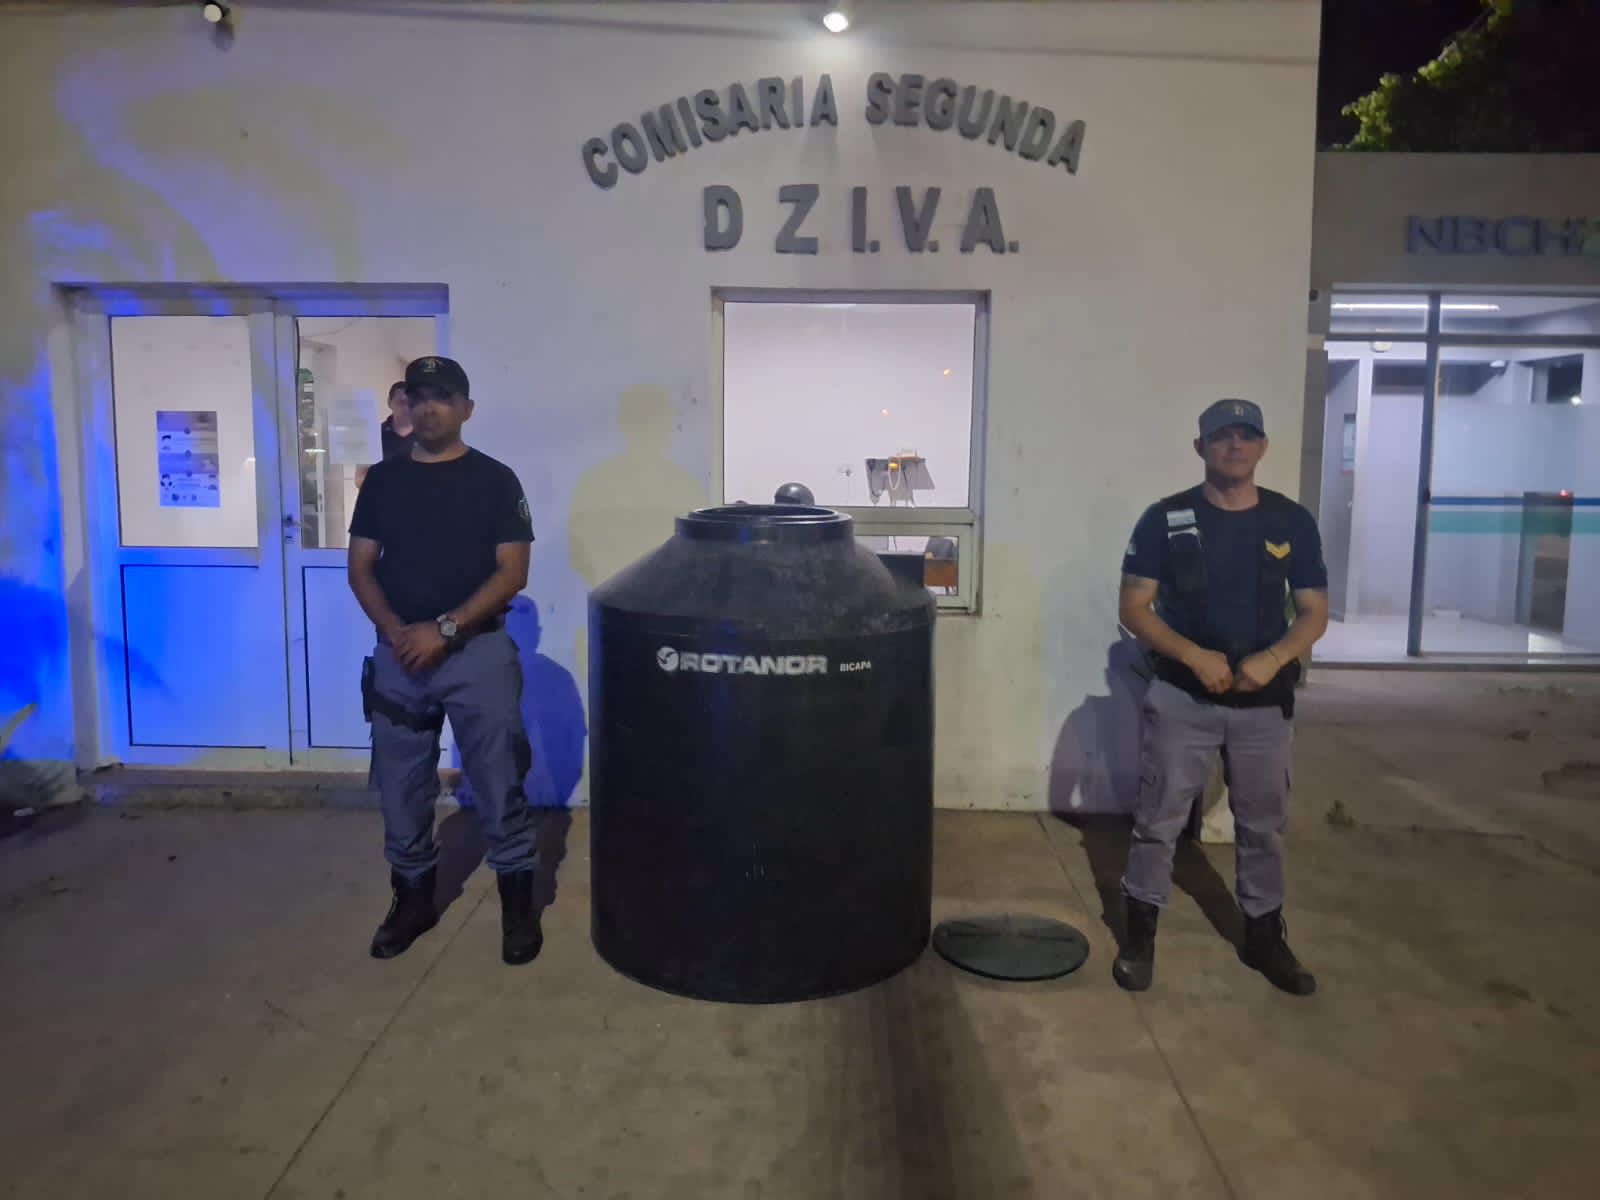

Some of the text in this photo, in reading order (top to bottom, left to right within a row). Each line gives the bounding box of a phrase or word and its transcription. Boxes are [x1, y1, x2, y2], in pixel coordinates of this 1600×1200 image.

[582, 72, 1087, 189] COMISARIA SEGUNDA
[703, 184, 744, 251] D
[775, 183, 820, 254] Z
[679, 652, 828, 675] ROTANOR
